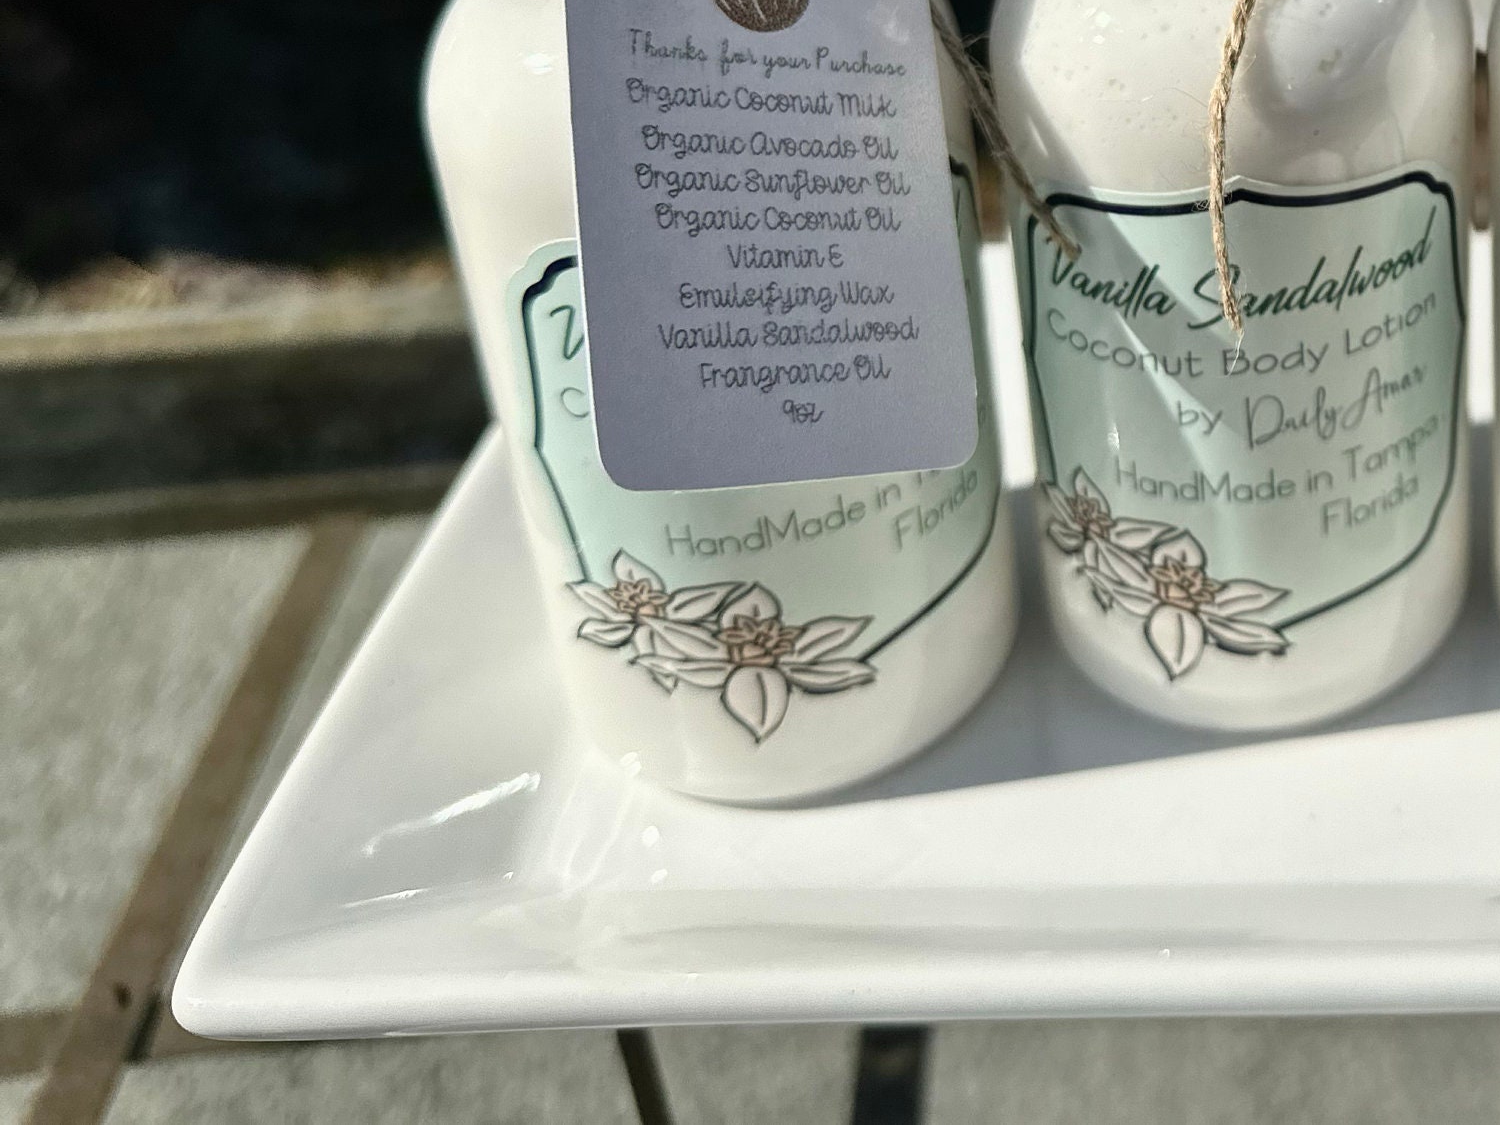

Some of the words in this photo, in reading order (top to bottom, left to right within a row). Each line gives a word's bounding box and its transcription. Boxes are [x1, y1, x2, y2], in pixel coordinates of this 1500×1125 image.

[629, 28, 708, 63] Thanks
[719, 38, 757, 75] for
[763, 51, 812, 78] your
[816, 46, 907, 77] Purchase
[625, 77, 731, 113] Organic
[734, 85, 833, 116] Coconut
[837, 91, 898, 118] Milk
[641, 125, 746, 160] Organic
[751, 131, 859, 159] Avocado
[862, 133, 900, 161] Oil
[635, 163, 741, 198] Organic
[745, 167, 872, 201] Sunflower
[874, 171, 911, 197] Oil
[654, 202, 759, 237] Organic
[763, 206, 863, 233] Coconut
[865, 205, 902, 233] Oil
[727, 243, 825, 269] Vitamin
[828, 243, 844, 269] E
[1047, 240, 1176, 320] Vanilla
[1188, 206, 1437, 331] Sandalwood
[679, 281, 837, 314] Emulsifying
[839, 280, 895, 306] Wax
[658, 322, 758, 350] Vanilla
[762, 315, 919, 347] Sandalwood
[1047, 307, 1203, 378] Coconut
[1222, 342, 1329, 377] Body
[1344, 293, 1437, 357] Lotion
[700, 360, 851, 394] Frangrance
[853, 354, 892, 381] Oil
[1177, 400, 1223, 435] by
[1115, 456, 1297, 504] HandMade
[1307, 469, 1334, 494] in
[1342, 414, 1439, 481] Tampa
[665, 495, 866, 557] HandMade
[875, 482, 902, 509] in
[893, 469, 978, 551] Florida
[1321, 476, 1420, 537] Florida
